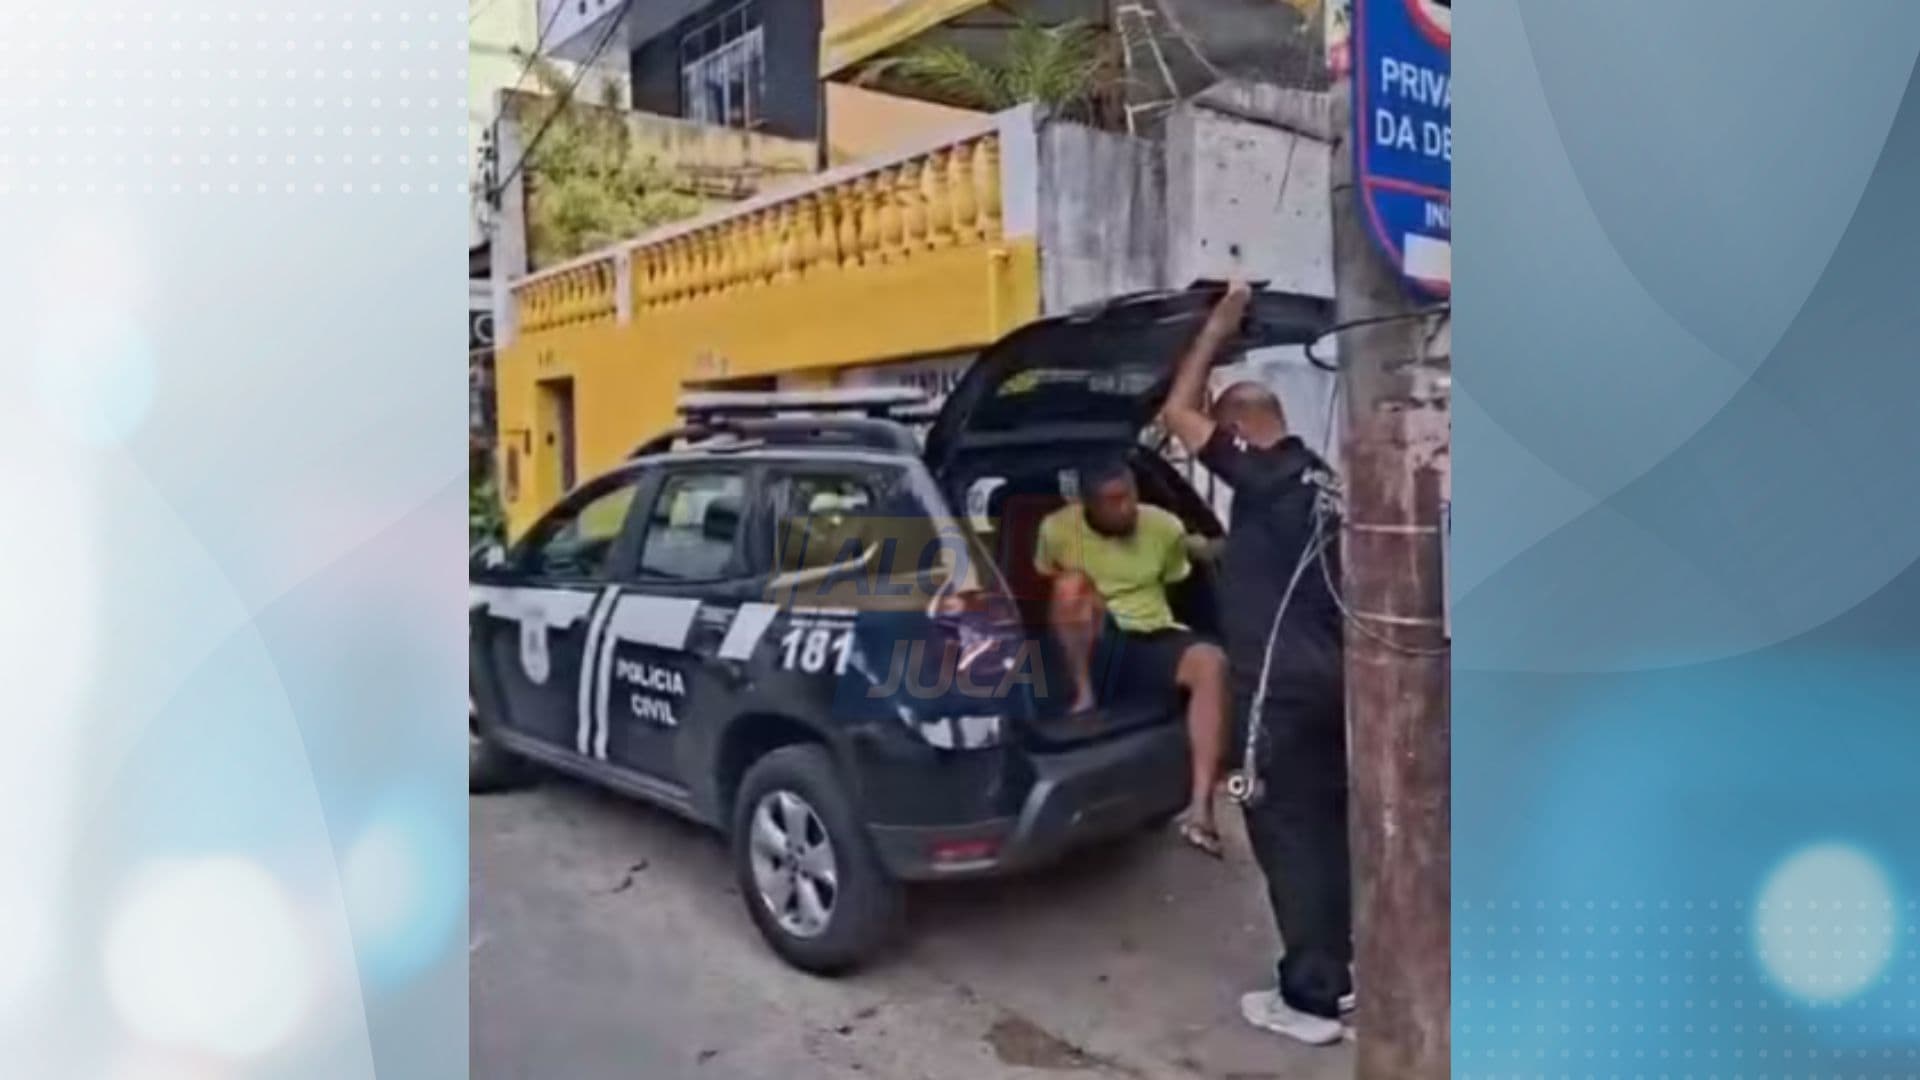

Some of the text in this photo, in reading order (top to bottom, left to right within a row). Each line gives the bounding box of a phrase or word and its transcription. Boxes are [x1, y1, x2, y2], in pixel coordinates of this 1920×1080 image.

[1376, 108, 1416, 152] DA
[780, 628, 855, 677] 181
[631, 693, 678, 726] CIVIL
